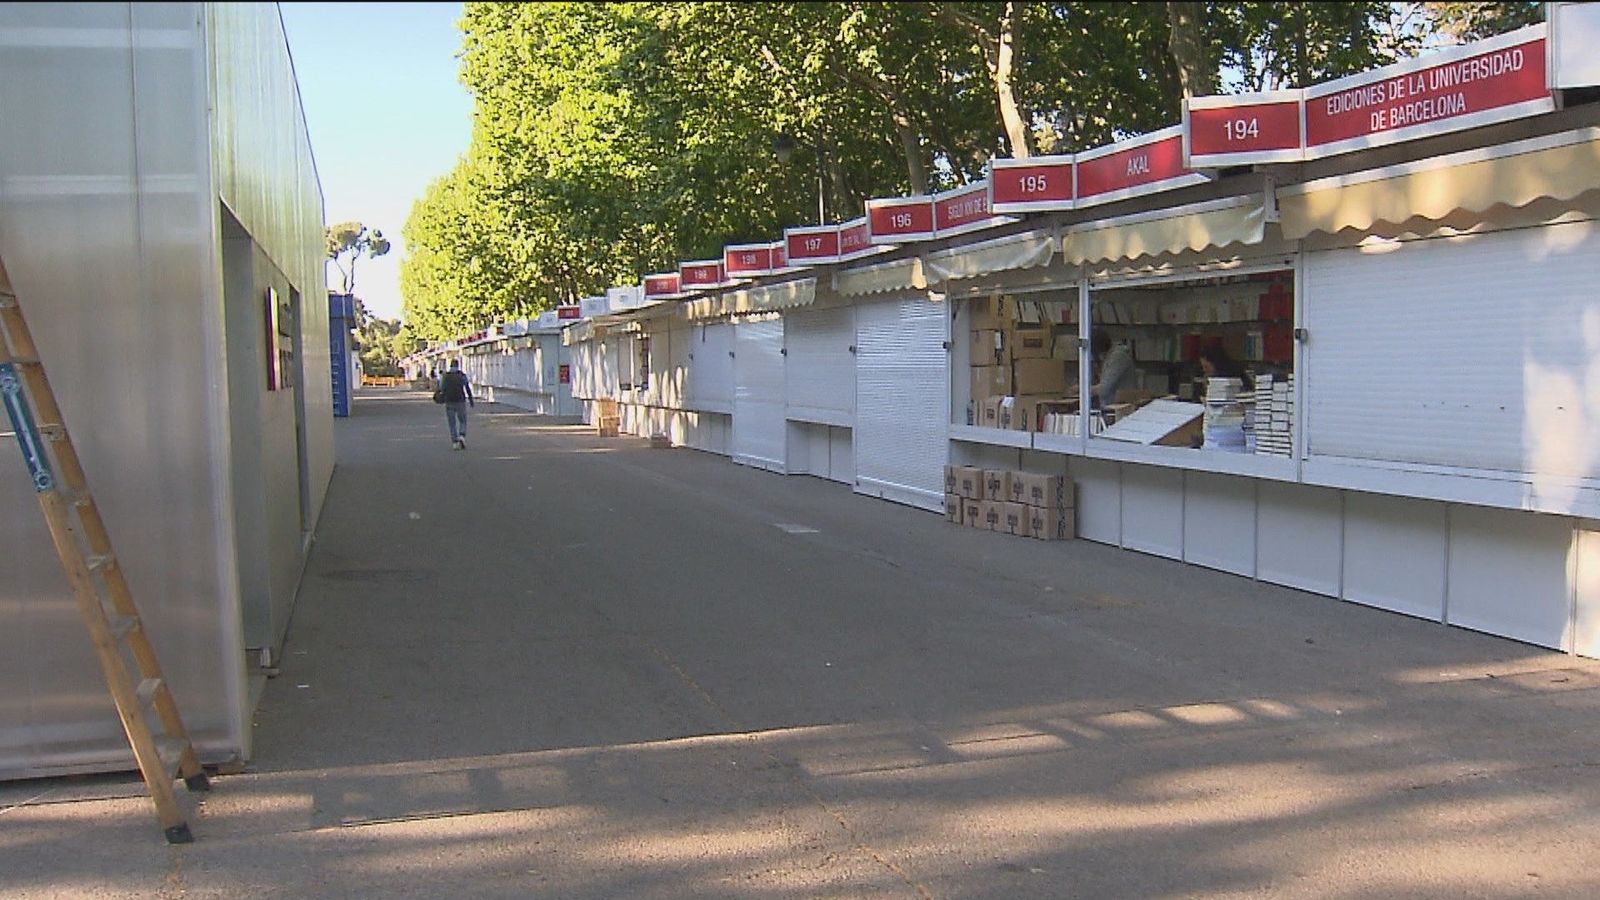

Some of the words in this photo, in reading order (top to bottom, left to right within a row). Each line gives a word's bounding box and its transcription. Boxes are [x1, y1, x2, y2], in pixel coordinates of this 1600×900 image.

[1326, 86, 1386, 116] EDICIONES
[1388, 79, 1405, 99] DE
[1409, 73, 1426, 94] LA
[1430, 49, 1524, 90] UNIVERSIDAD
[1370, 112, 1387, 132] DE
[1390, 93, 1466, 127] BARCELONA
[1224, 118, 1260, 141] 194
[1126, 155, 1150, 175] AKAL
[1018, 175, 1047, 193] 195
[890, 213, 912, 228] 196
[804, 238, 821, 252] 197
